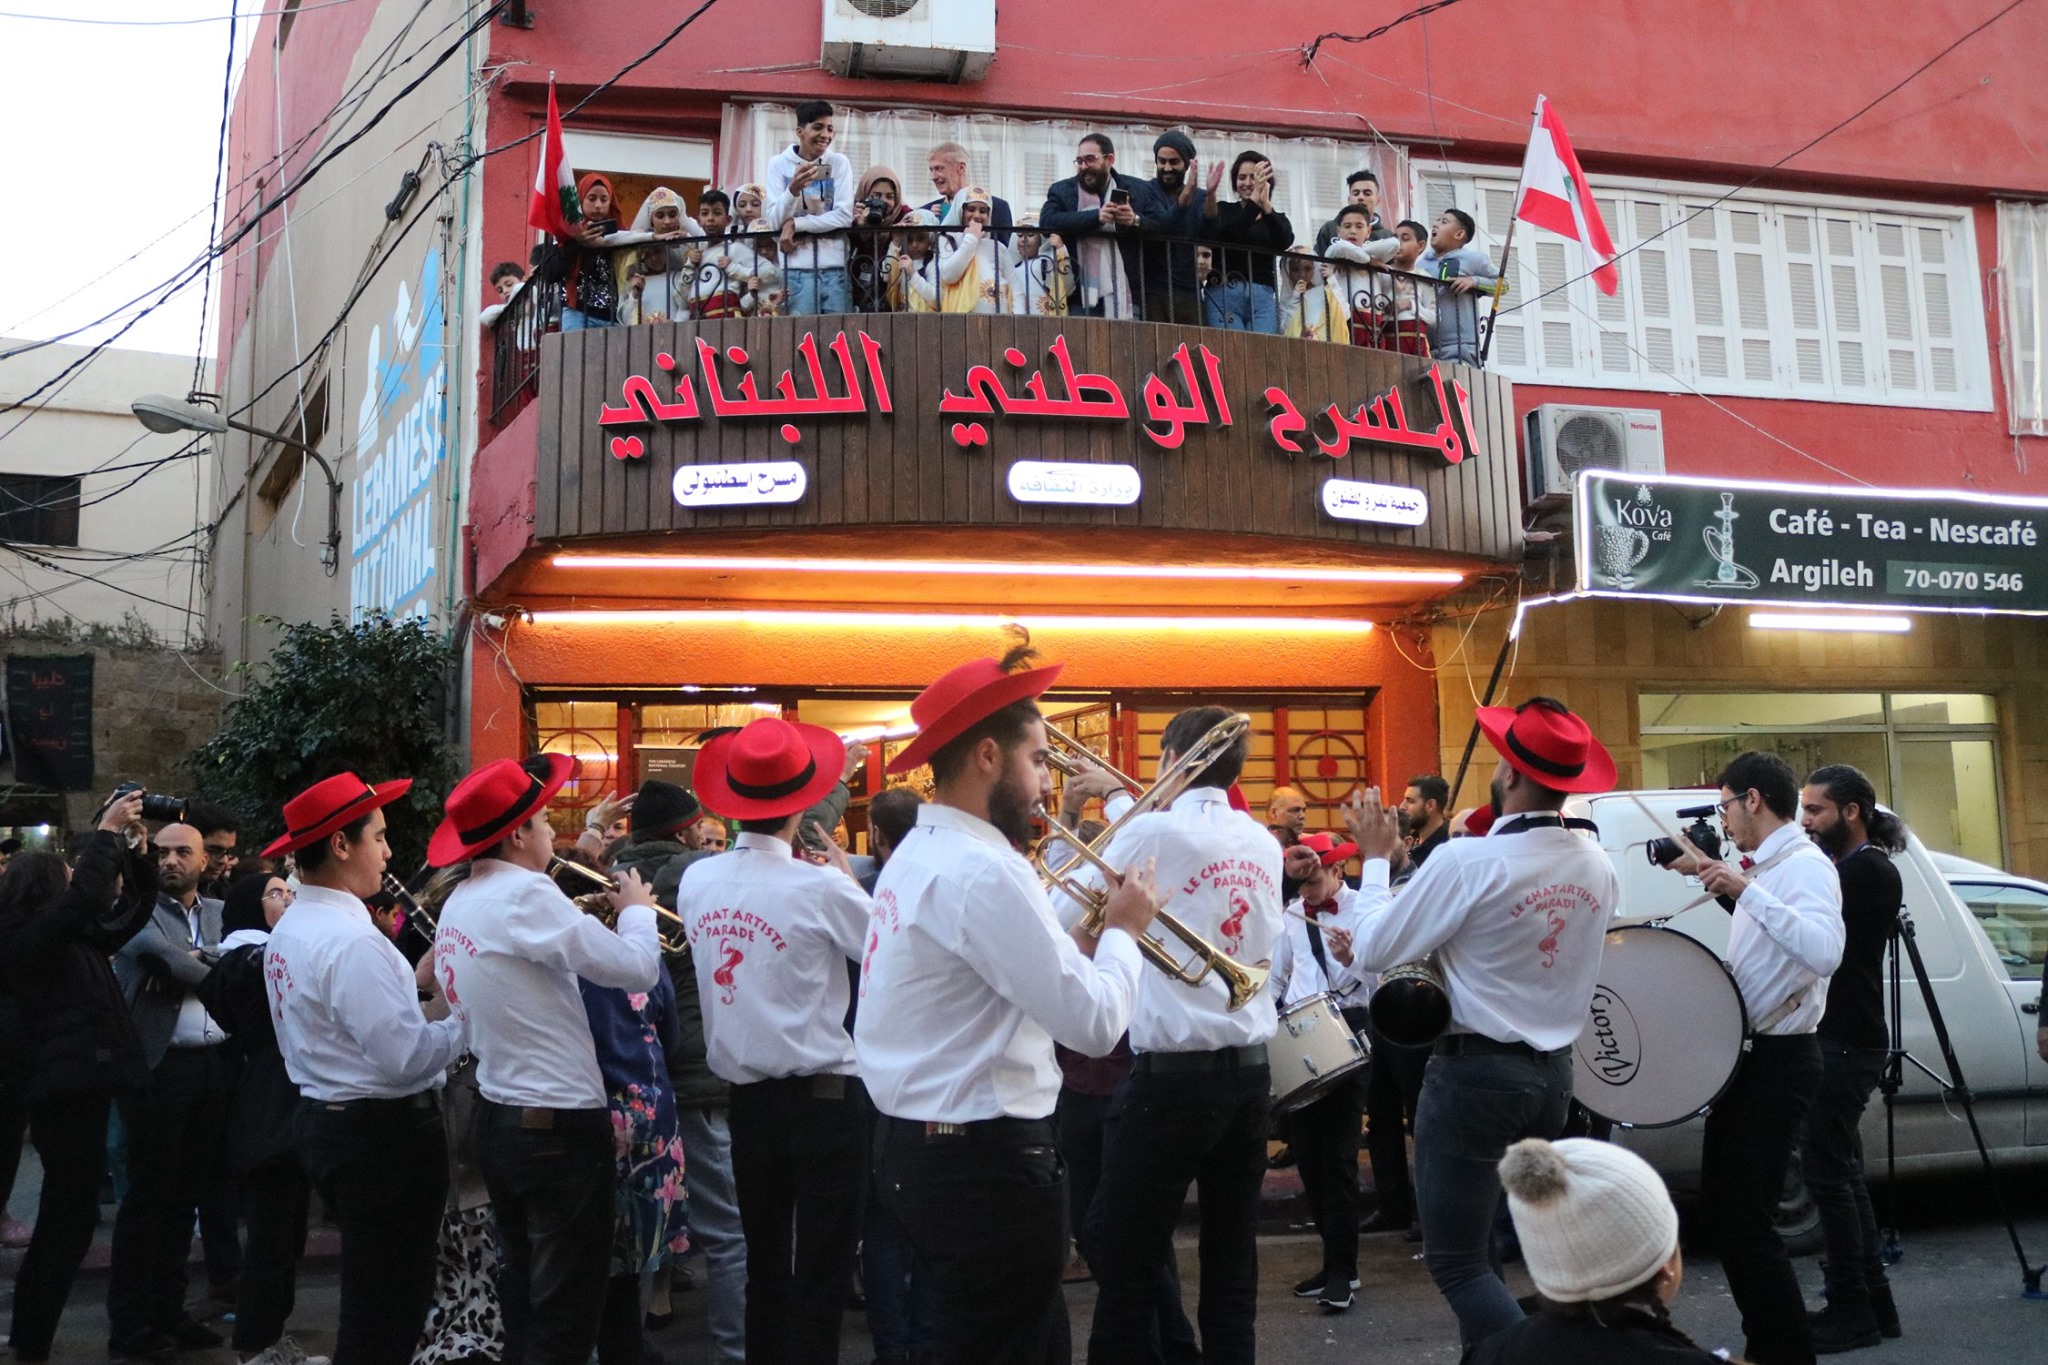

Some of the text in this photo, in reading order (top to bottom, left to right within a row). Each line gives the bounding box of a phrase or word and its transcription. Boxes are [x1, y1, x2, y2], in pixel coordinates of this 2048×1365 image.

[597, 330, 1479, 464] المسرح الوطني اللبناني
[1630, 422, 1657, 431] National
[352, 359, 446, 557] LEBANESE
[756, 473, 798, 495] مسرح
[1651, 530, 1672, 541] Café
[1769, 508, 1833, 536] Café
[1856, 513, 1906, 540] Tea
[1930, 517, 2037, 546] Nescafé
[350, 490, 435, 630] NATIONAL
[1770, 558, 1873, 592] Argileh
[1904, 569, 2023, 591] 70-070 546
[1183, 876, 1200, 895] LE
[1200, 859, 1235, 879] CHAT
[1213, 874, 1257, 891] PARADE
[1510, 884, 1600, 918] LE CHAT ARTISTE
[1535, 898, 1577, 913] PARADE
[444, 926, 478, 958] ARTISTE
[690, 908, 787, 952] LE CHAT ARTISTE
[706, 924, 755, 942] PARADE
[1590, 993, 1634, 1077] Victory
